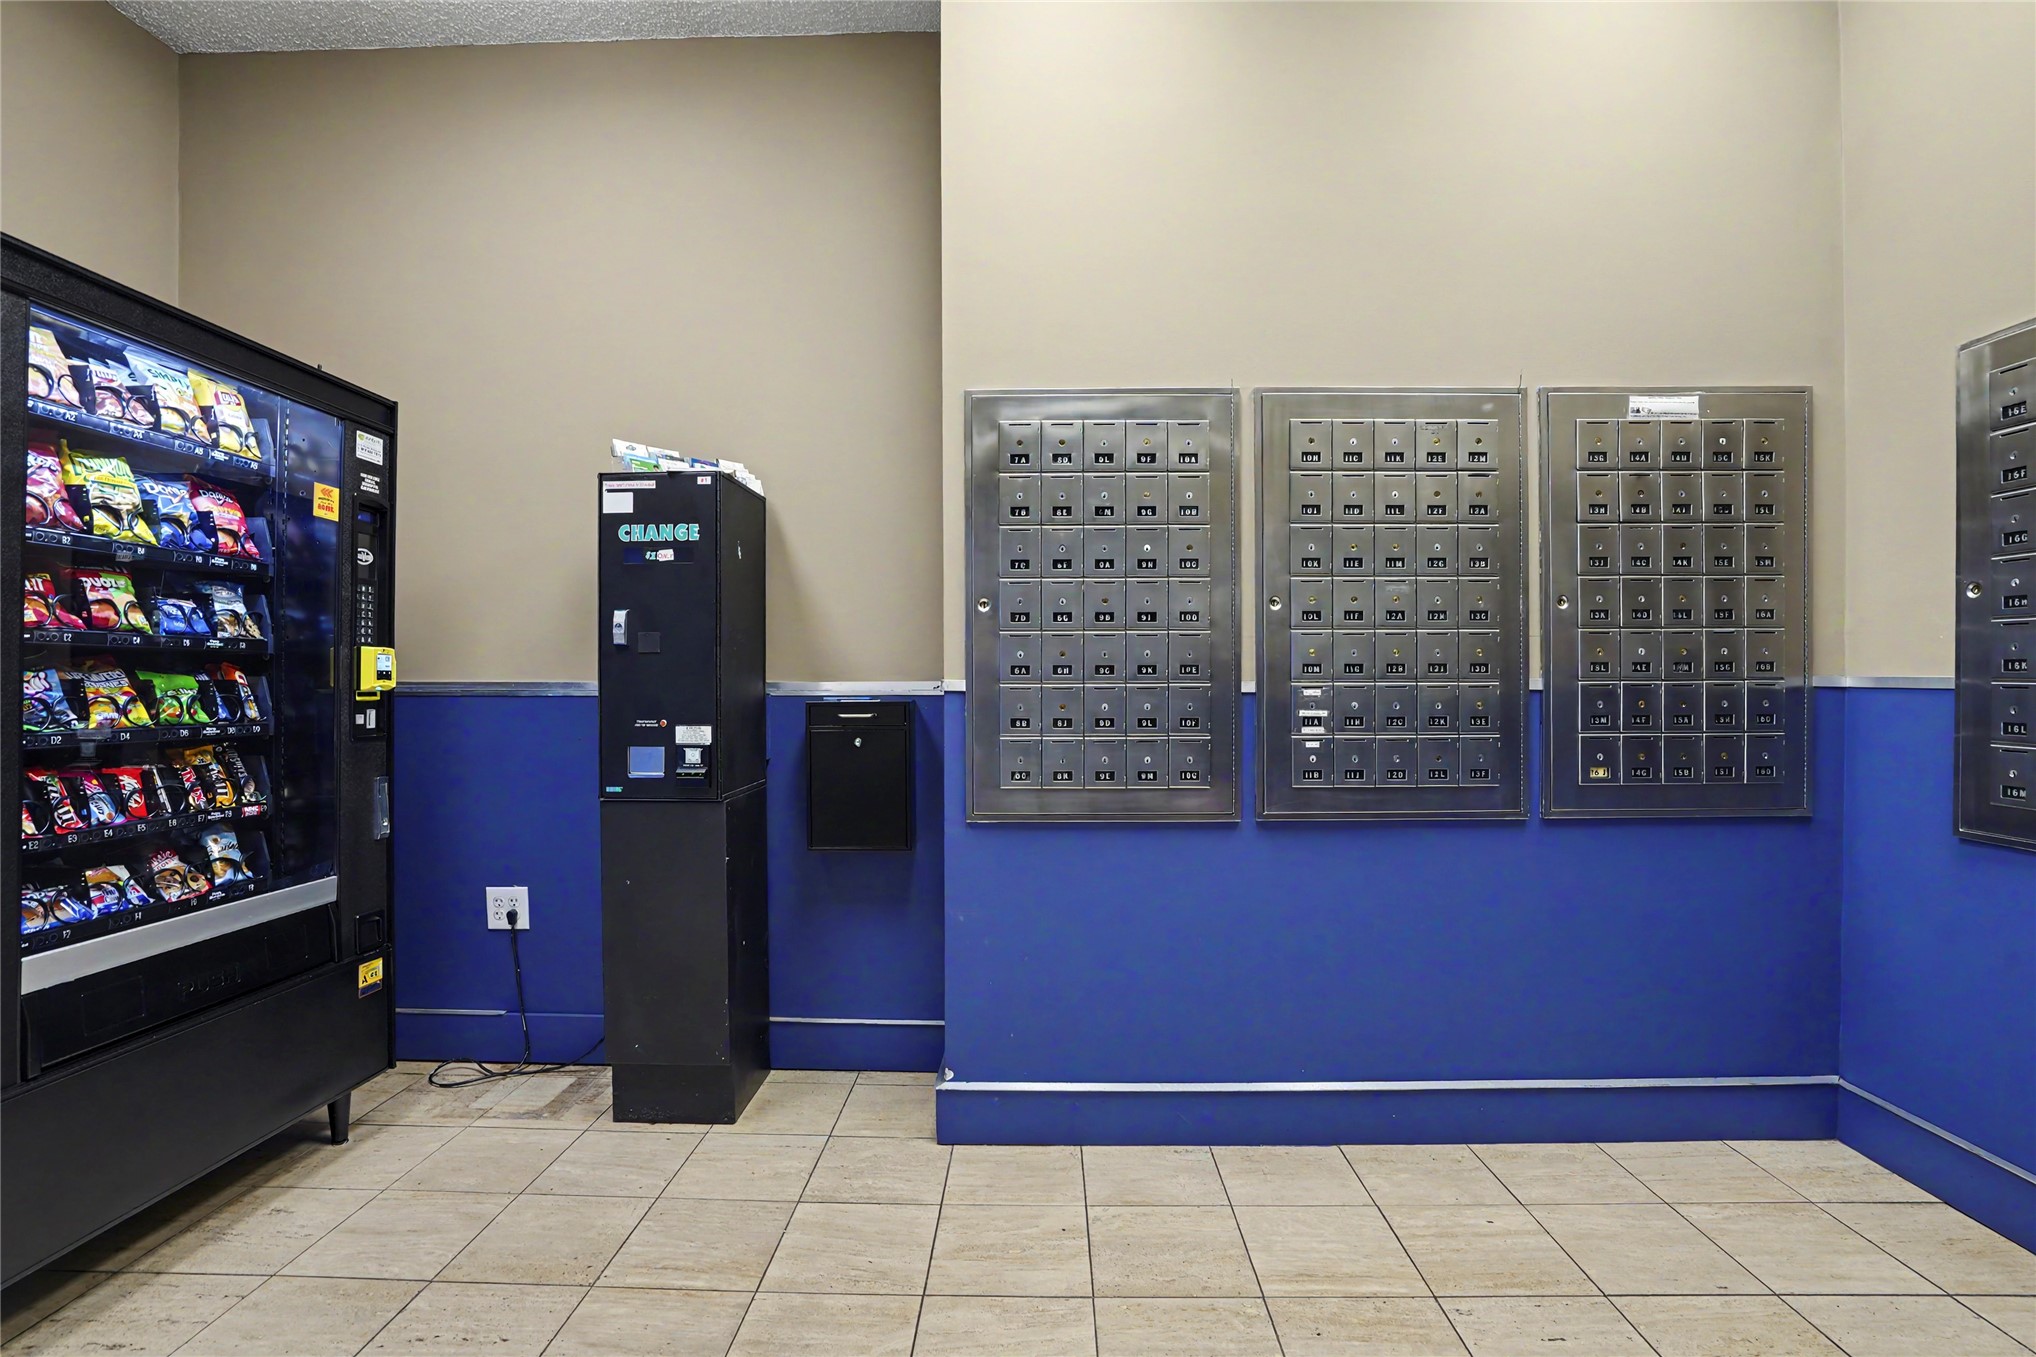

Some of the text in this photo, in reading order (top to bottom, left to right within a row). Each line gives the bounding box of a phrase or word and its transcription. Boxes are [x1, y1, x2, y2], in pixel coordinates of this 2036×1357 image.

[2008, 405, 2027, 417] 16E
[2008, 469, 2026, 481] 16F
[618, 523, 700, 542] CHANGE
[2009, 533, 2028, 543] 16G
[2009, 662, 2027, 670] 16K
[2008, 725, 2026, 733] 16L
[2007, 788, 2027, 797] 16M
